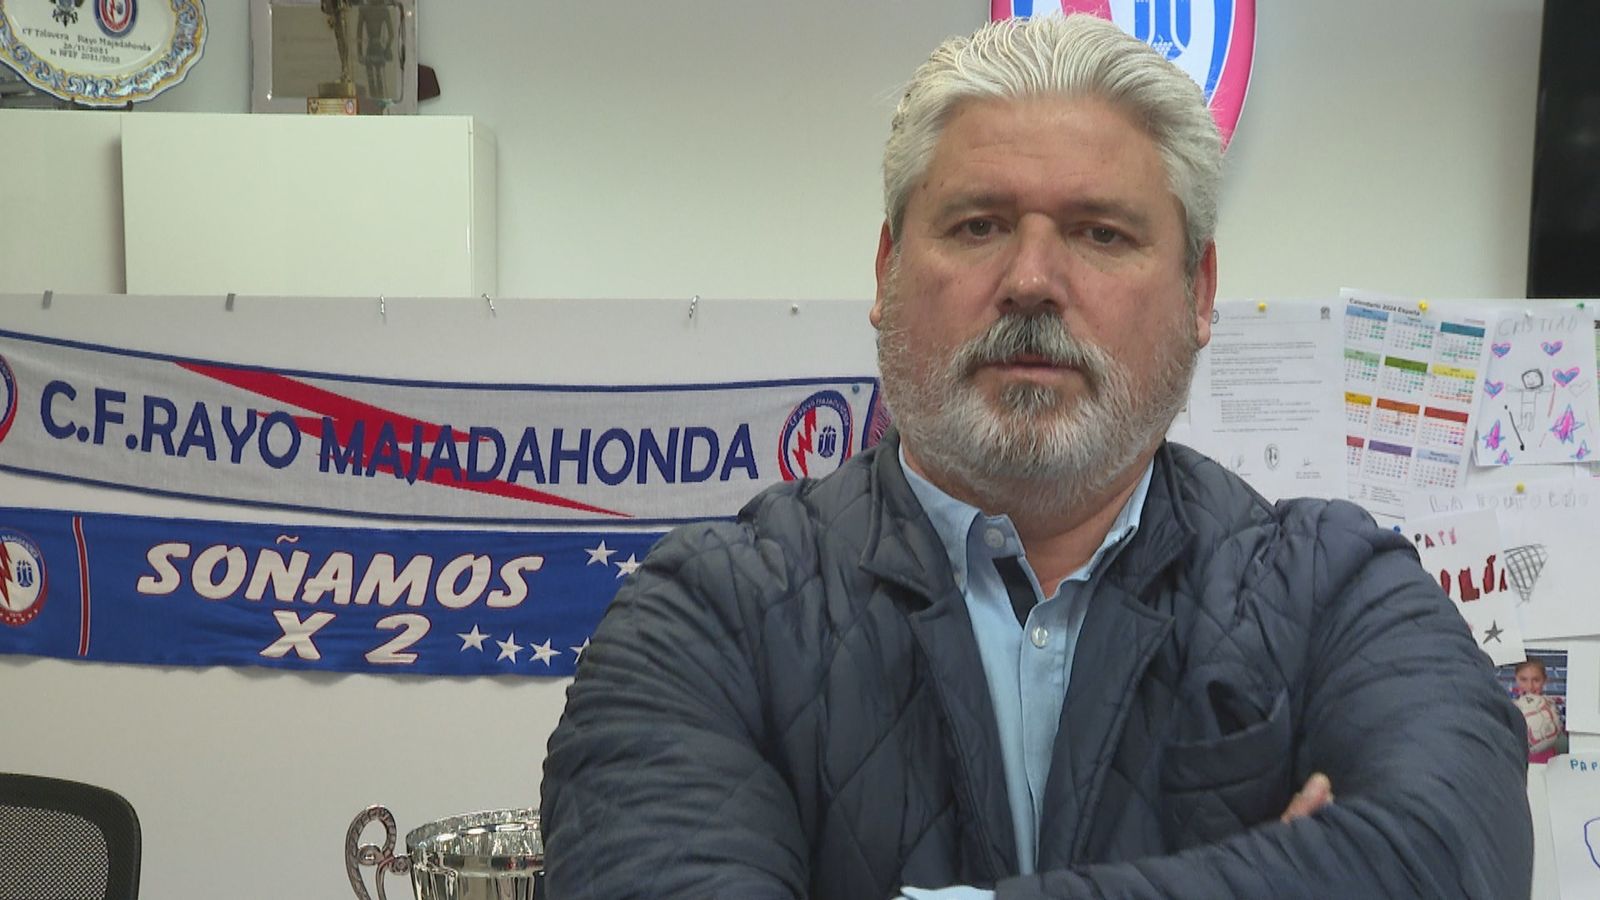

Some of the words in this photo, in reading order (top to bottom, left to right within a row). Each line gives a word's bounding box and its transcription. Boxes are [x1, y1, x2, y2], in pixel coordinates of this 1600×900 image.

[318, 416, 759, 486] MAJADAHONDA
[136, 533, 545, 609] SOÑAMOS
[258, 609, 337, 661] X
[364, 611, 432, 664] 2
